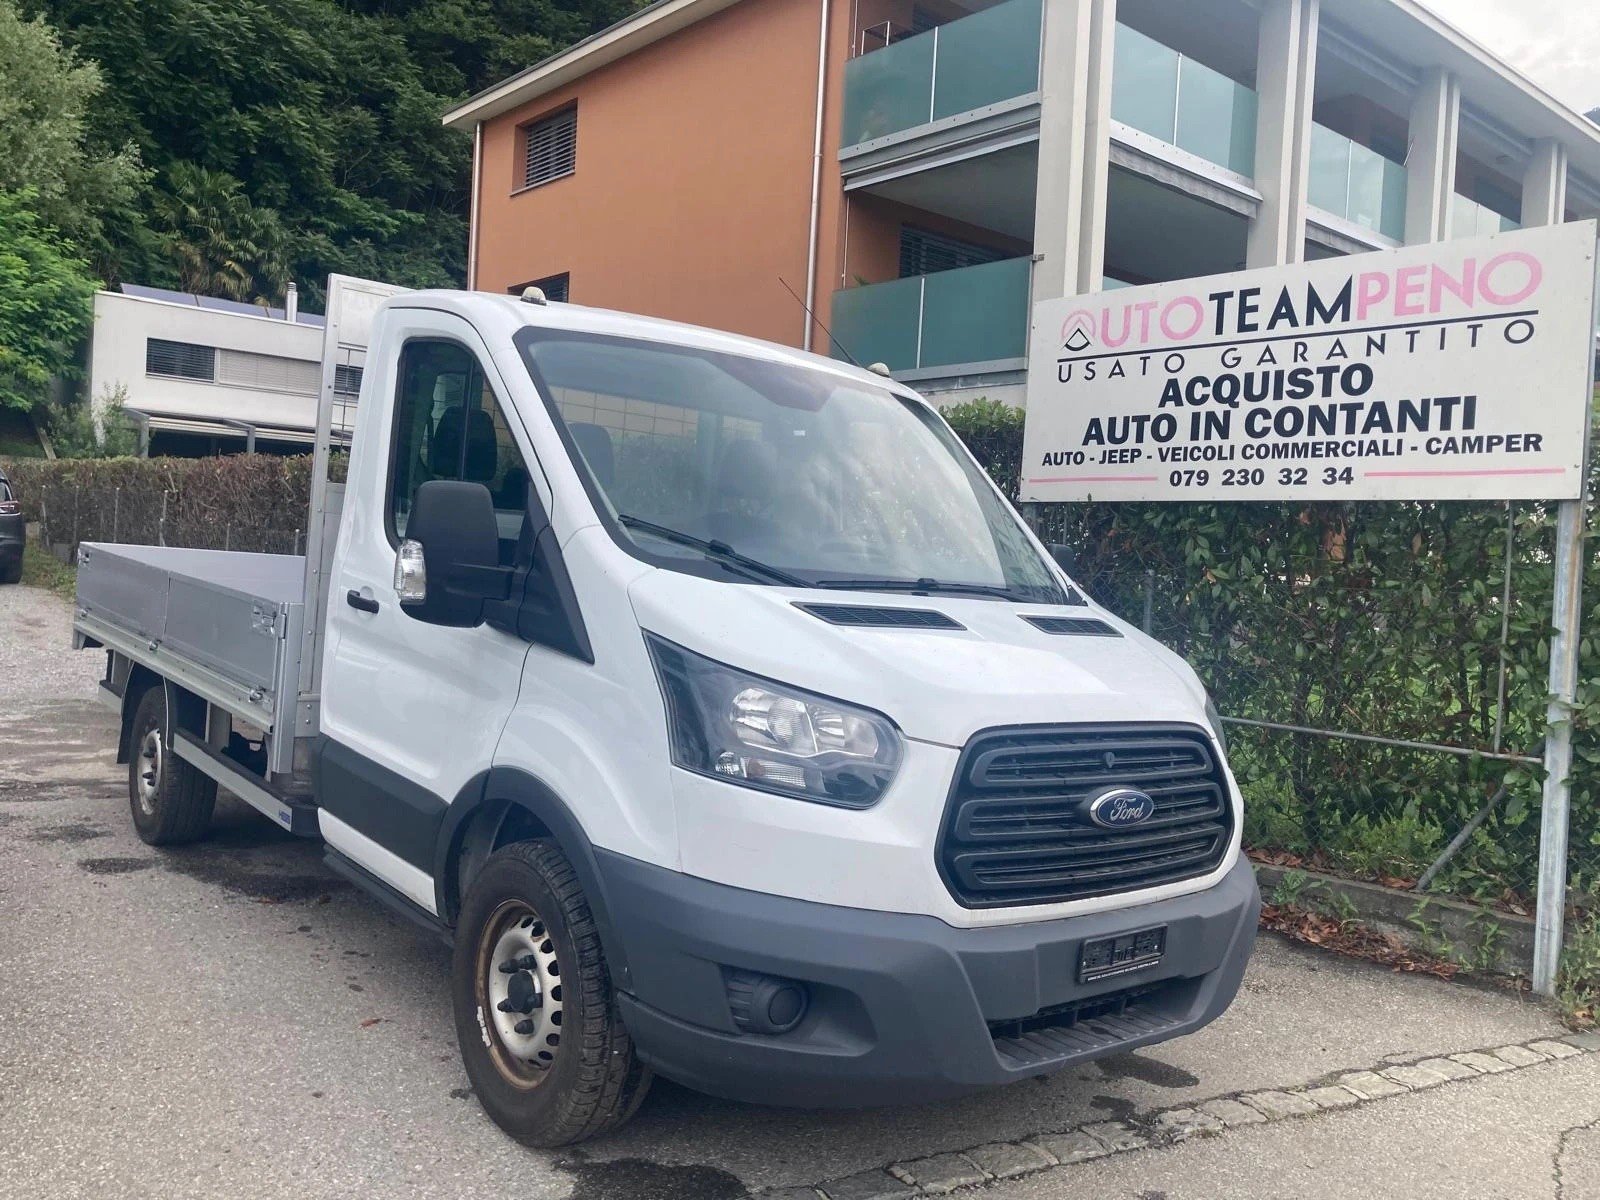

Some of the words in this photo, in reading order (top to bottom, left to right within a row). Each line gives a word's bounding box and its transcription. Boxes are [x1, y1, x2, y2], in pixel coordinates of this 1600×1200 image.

[1058, 353, 1185, 383] USATO
[1221, 319, 1535, 369] GARANTITO
[1158, 363, 1374, 408] ACQUISTO
[1082, 413, 1178, 446] AUTO
[1190, 410, 1231, 441] IN
[1244, 395, 1477, 439] CONTANTI
[1042, 451, 1085, 466] AUTO
[1098, 448, 1142, 465] JEEP
[1158, 445, 1235, 462] VEICOLI
[1241, 438, 1404, 460] COMMERCIALI
[1425, 433, 1543, 456] CAMPER
[1169, 470, 1209, 487] 079
[1221, 468, 1265, 486] 230
[1278, 468, 1308, 485] 32
[1322, 467, 1354, 485] 34
[1110, 797, 1144, 821] Ford
